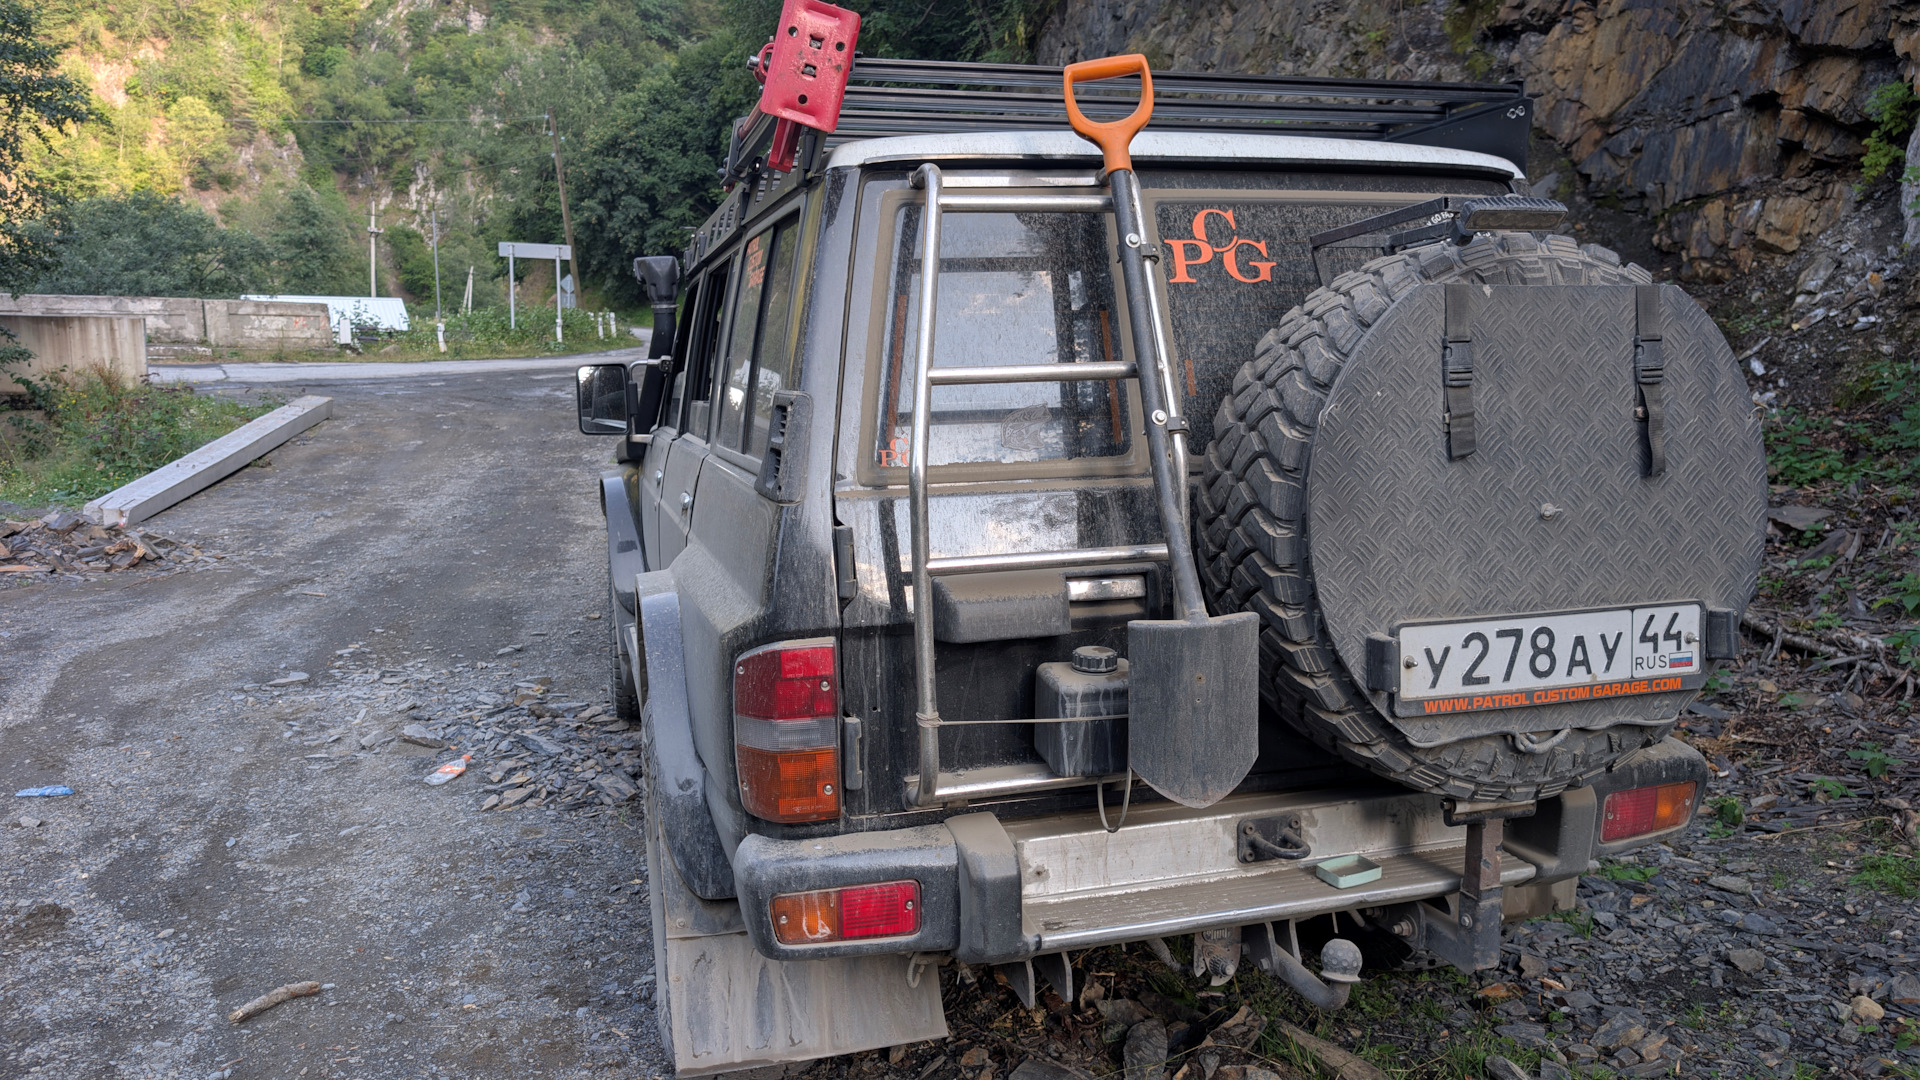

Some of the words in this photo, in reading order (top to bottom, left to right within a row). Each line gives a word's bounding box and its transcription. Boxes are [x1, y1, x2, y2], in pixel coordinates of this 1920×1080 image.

[1634, 654, 1668, 672] RUS
[1533, 686, 1590, 705] CUSTOM
[1592, 677, 1682, 698] GARAGE.COM
